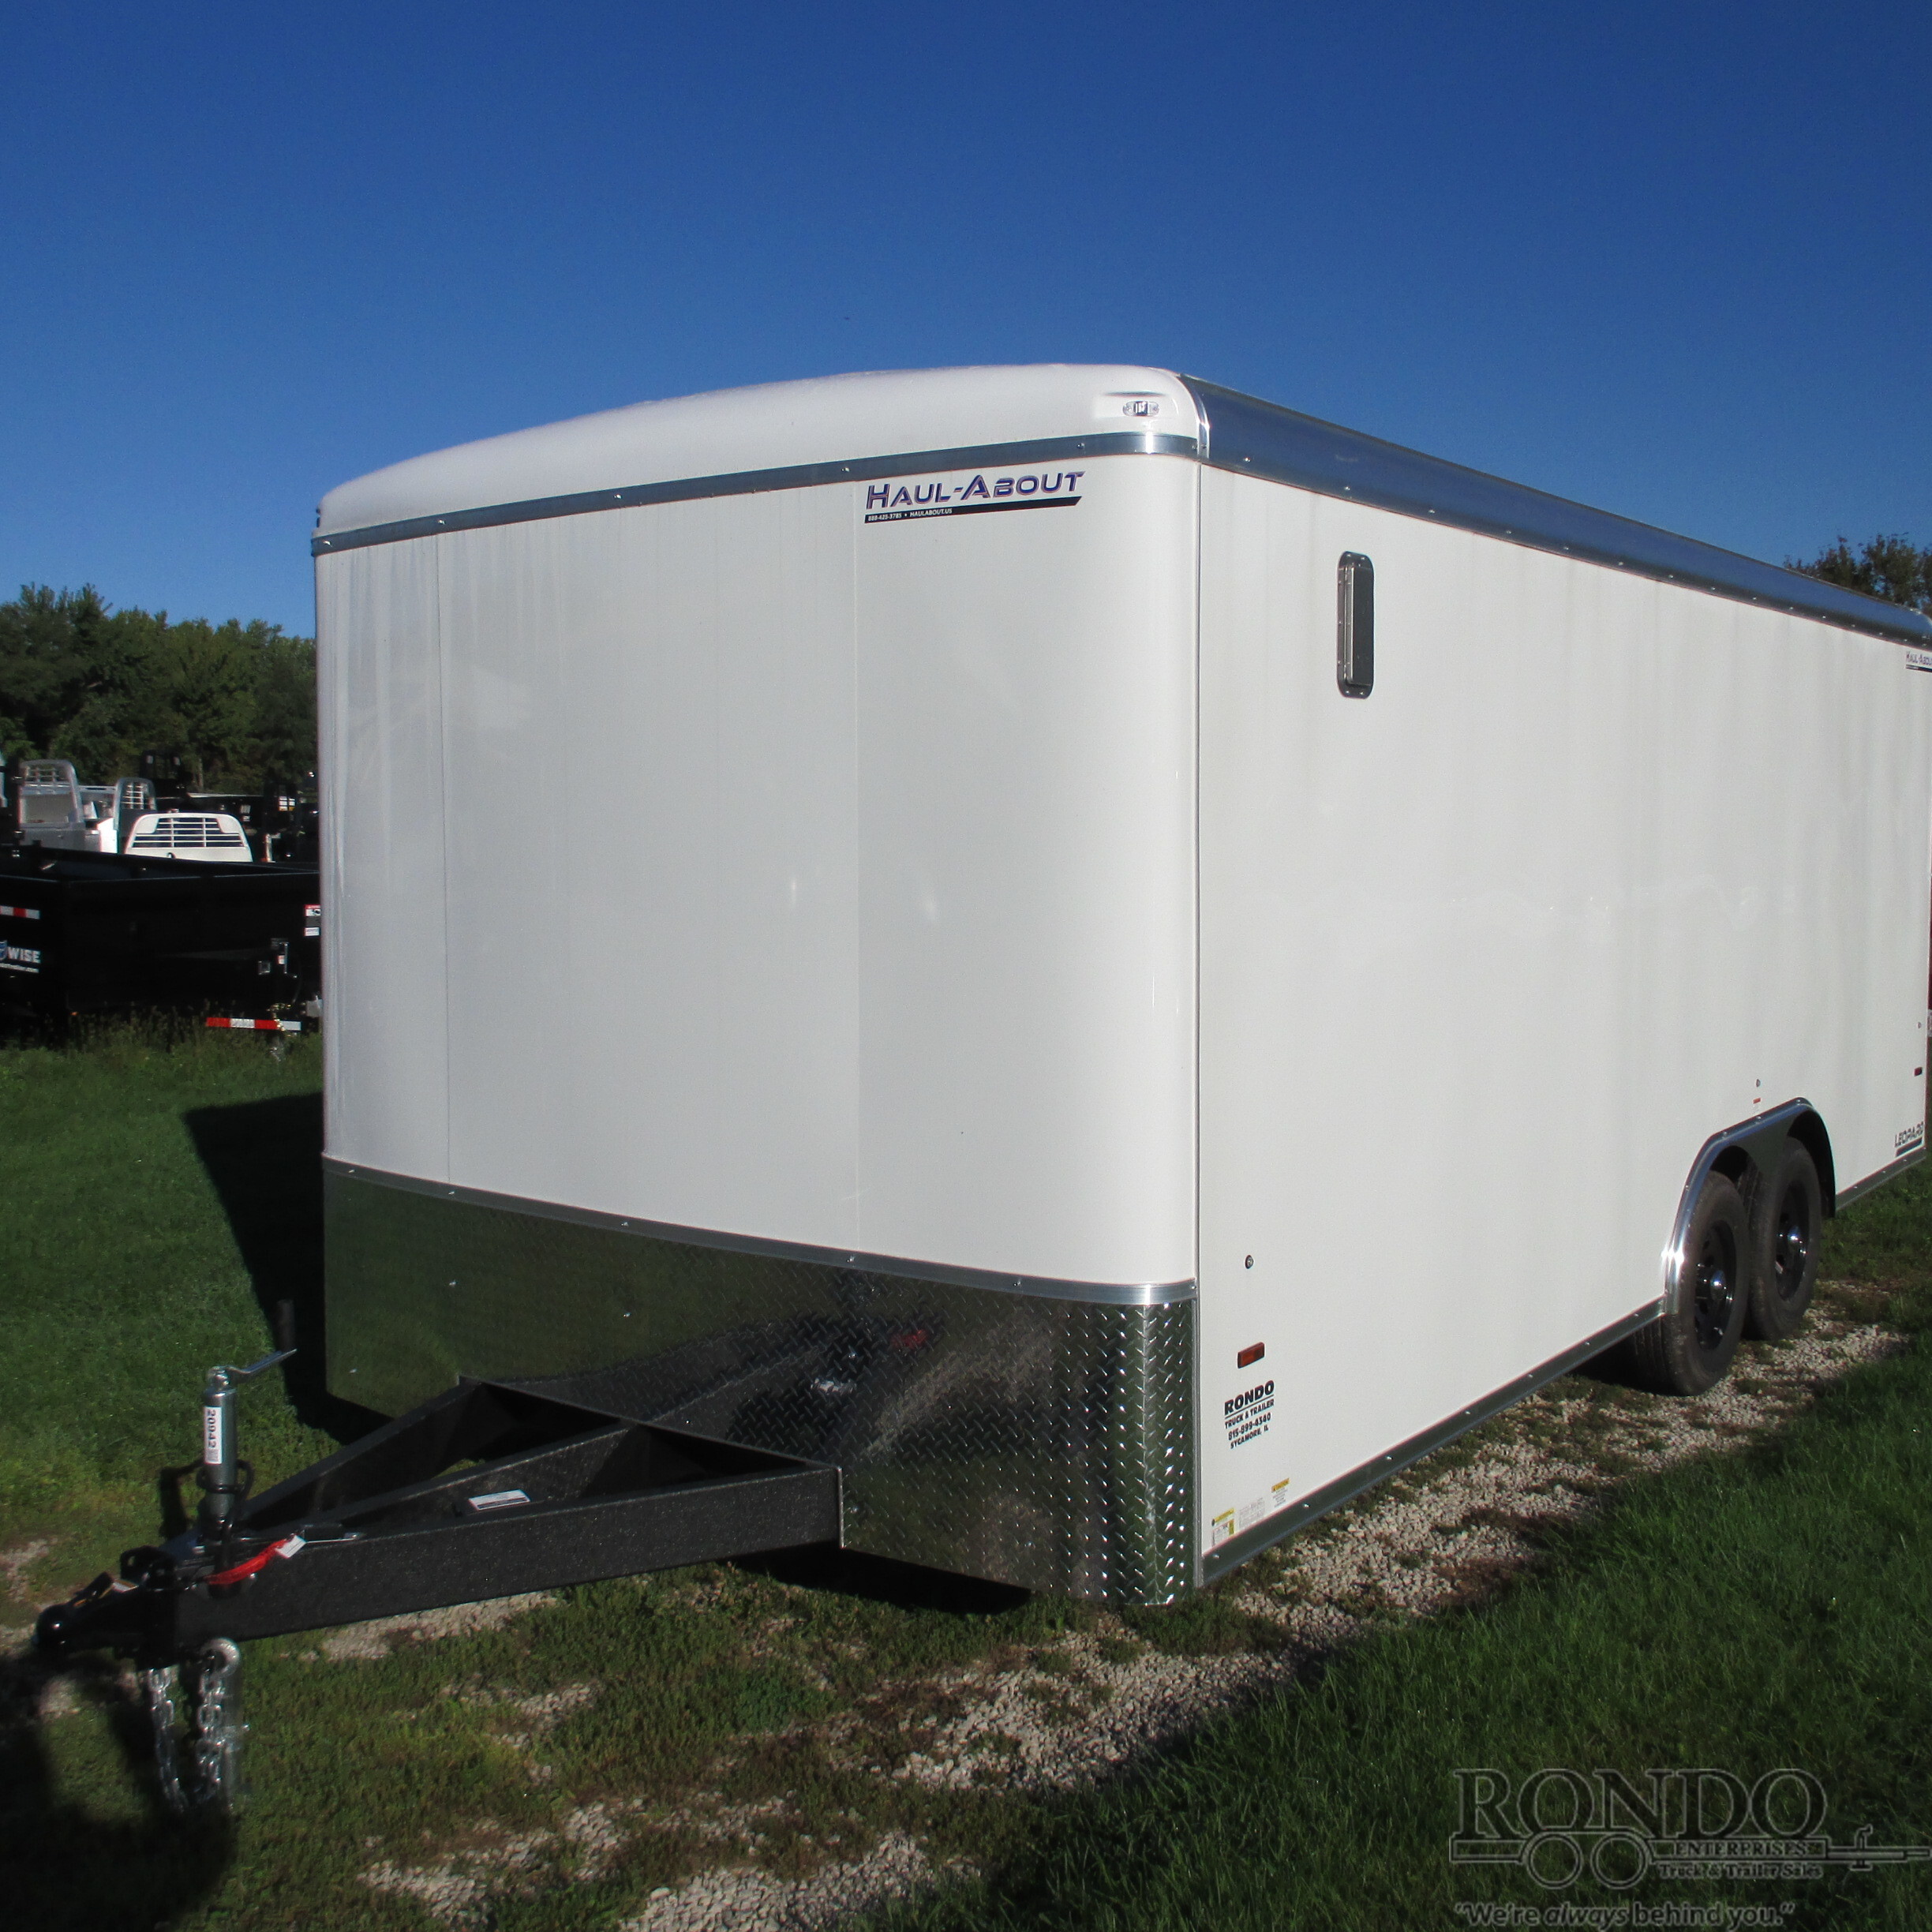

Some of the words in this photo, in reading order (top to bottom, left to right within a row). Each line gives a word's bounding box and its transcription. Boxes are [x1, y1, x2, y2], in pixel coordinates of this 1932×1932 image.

[866, 471, 1086, 510] HAUL-ABOUT
[909, 507, 953, 518] HAULABOUT.US
[7, 946, 41, 964] WISE
[1224, 1380, 1275, 1416] RONDO
[1225, 1413, 1244, 1429] TRUCK
[1250, 1398, 1275, 1417] TRAILER
[208, 1409, 217, 1448] 20942
[1230, 1427, 1263, 1449] SYCAMORE,
[1264, 1424, 1269, 1432] IL
